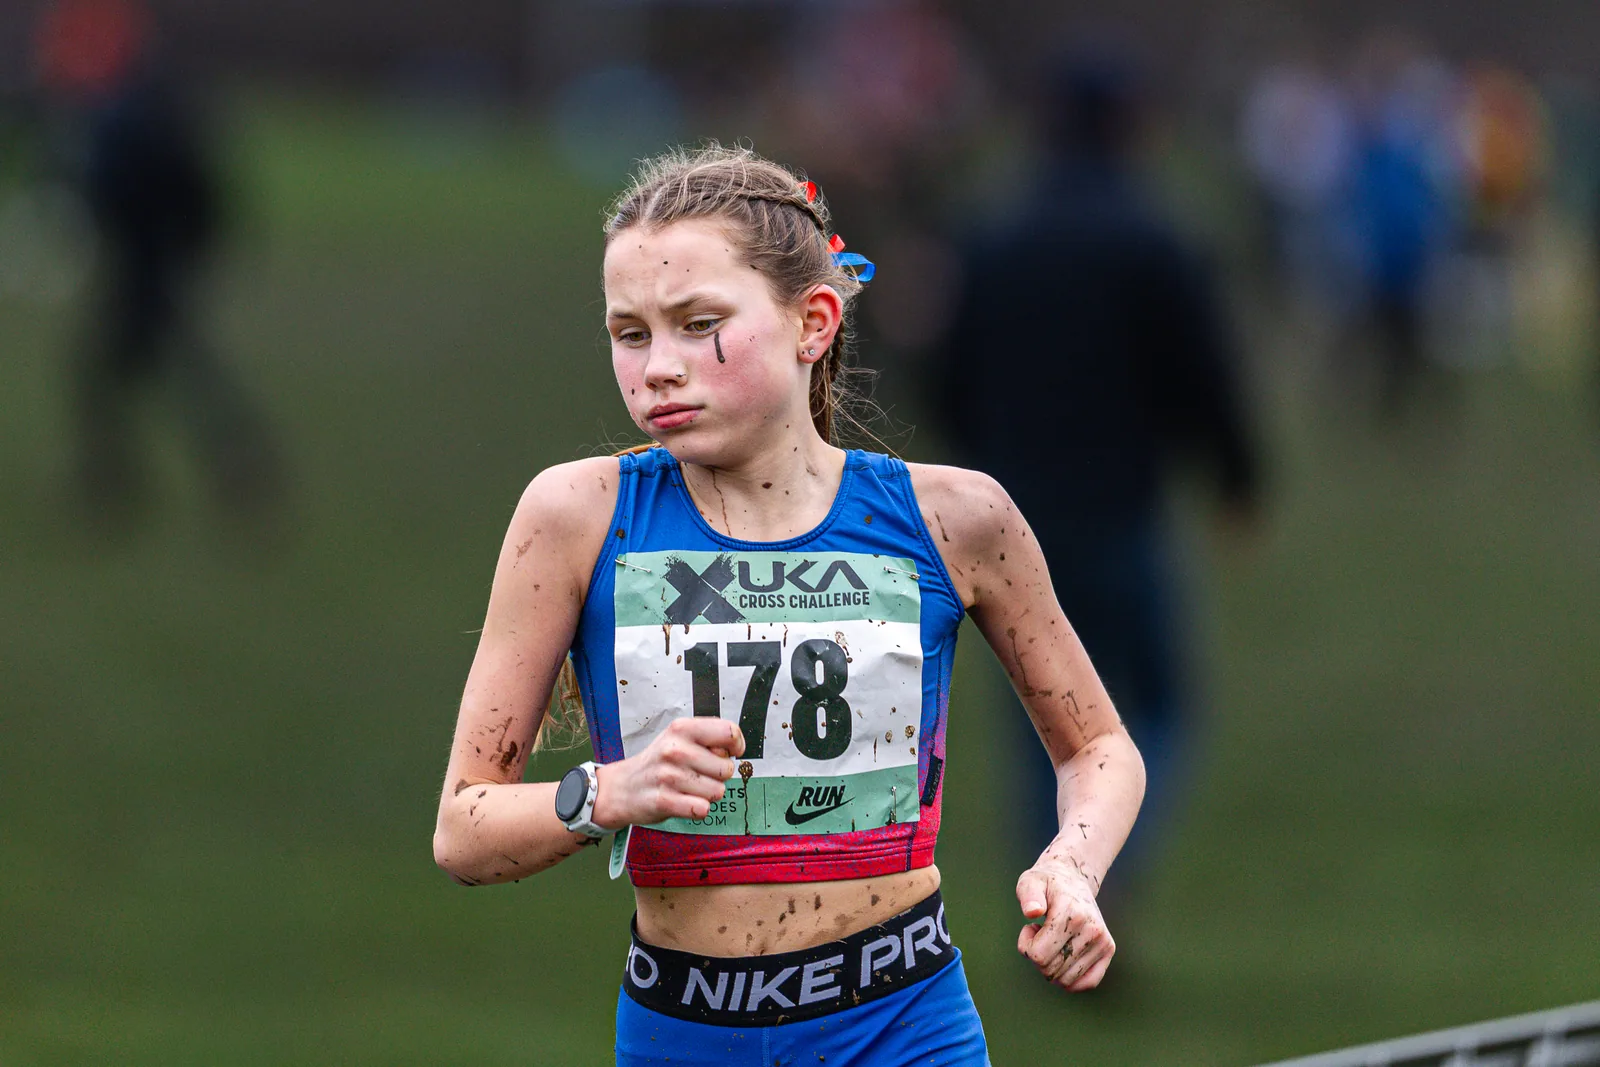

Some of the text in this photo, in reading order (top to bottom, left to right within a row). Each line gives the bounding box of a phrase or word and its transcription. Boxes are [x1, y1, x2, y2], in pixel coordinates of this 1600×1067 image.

[738, 560, 869, 593] UKA
[739, 591, 870, 609] CROSS CHALLENGE
[684, 638, 852, 760] 178
[709, 801, 737, 813] OES
[796, 785, 846, 807] RUN
[681, 954, 844, 1012] NIKE
